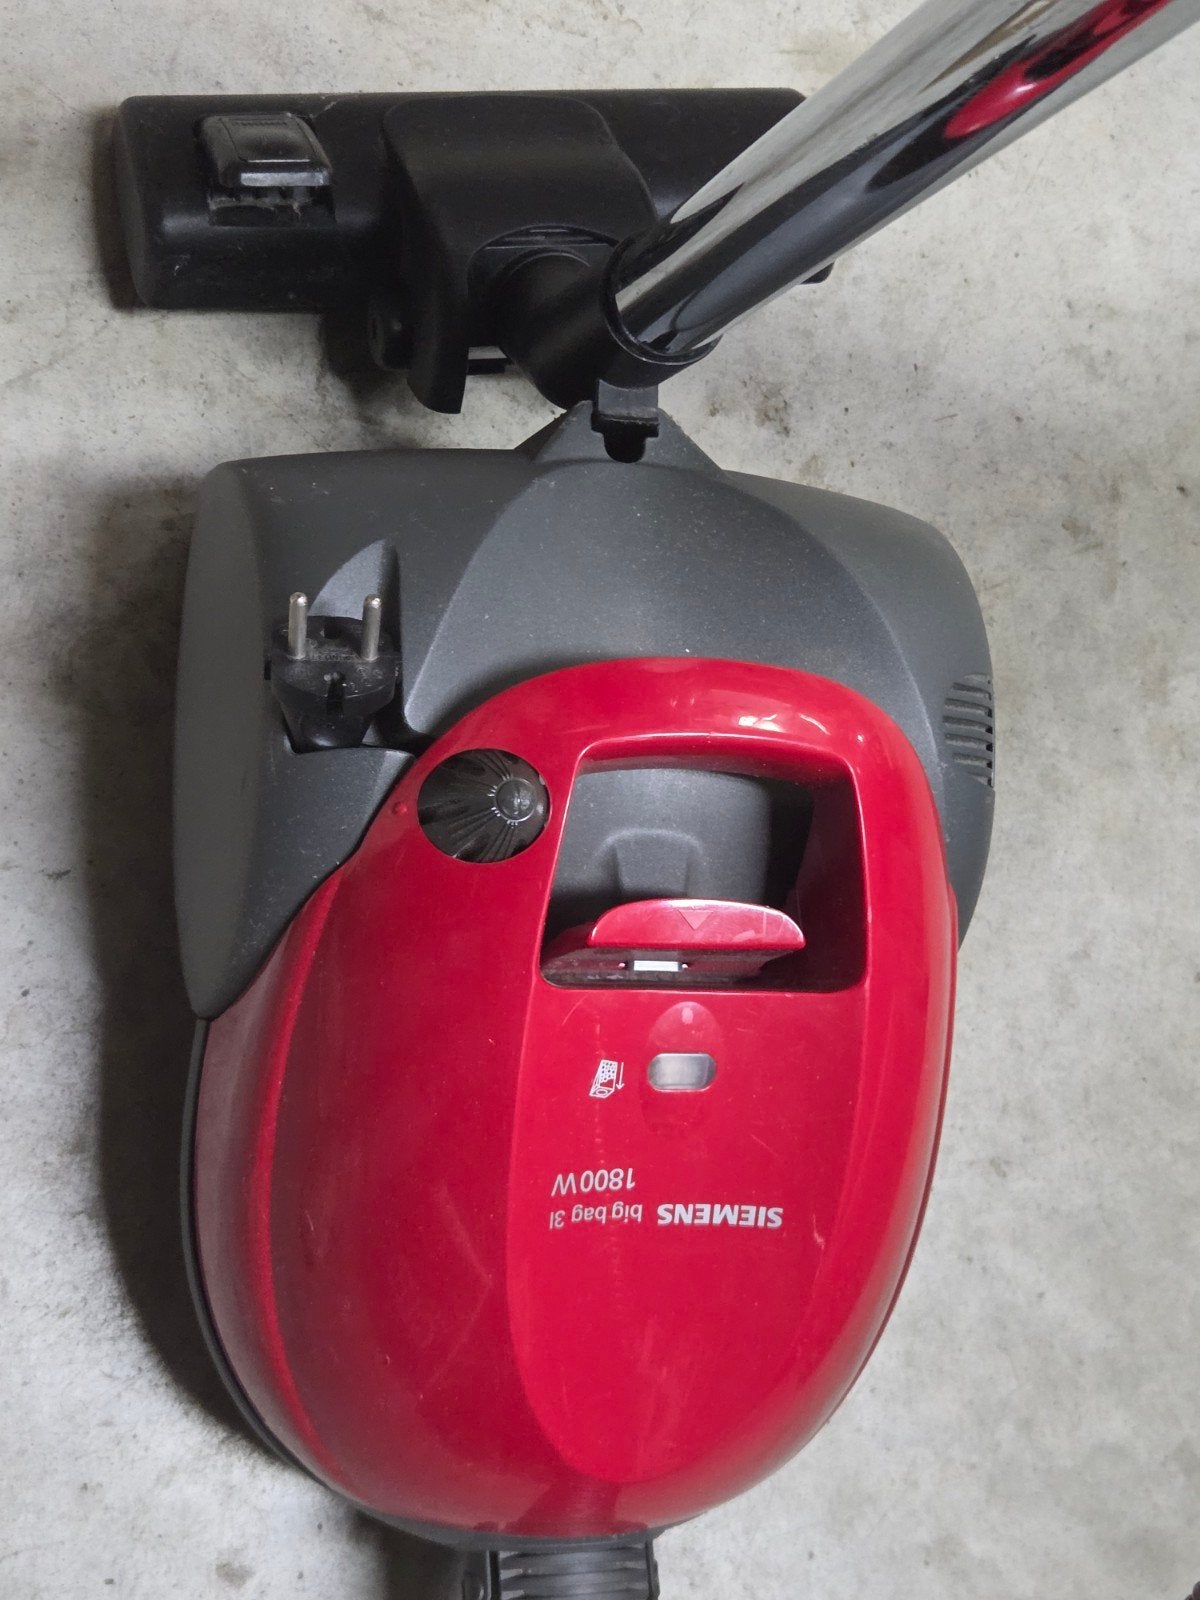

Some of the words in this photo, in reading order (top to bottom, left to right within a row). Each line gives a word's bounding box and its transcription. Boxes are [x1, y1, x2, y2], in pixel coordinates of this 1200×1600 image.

[571, 1204, 607, 1226] bag
[611, 1201, 643, 1224] big
[656, 1203, 784, 1229] SIEMENS
